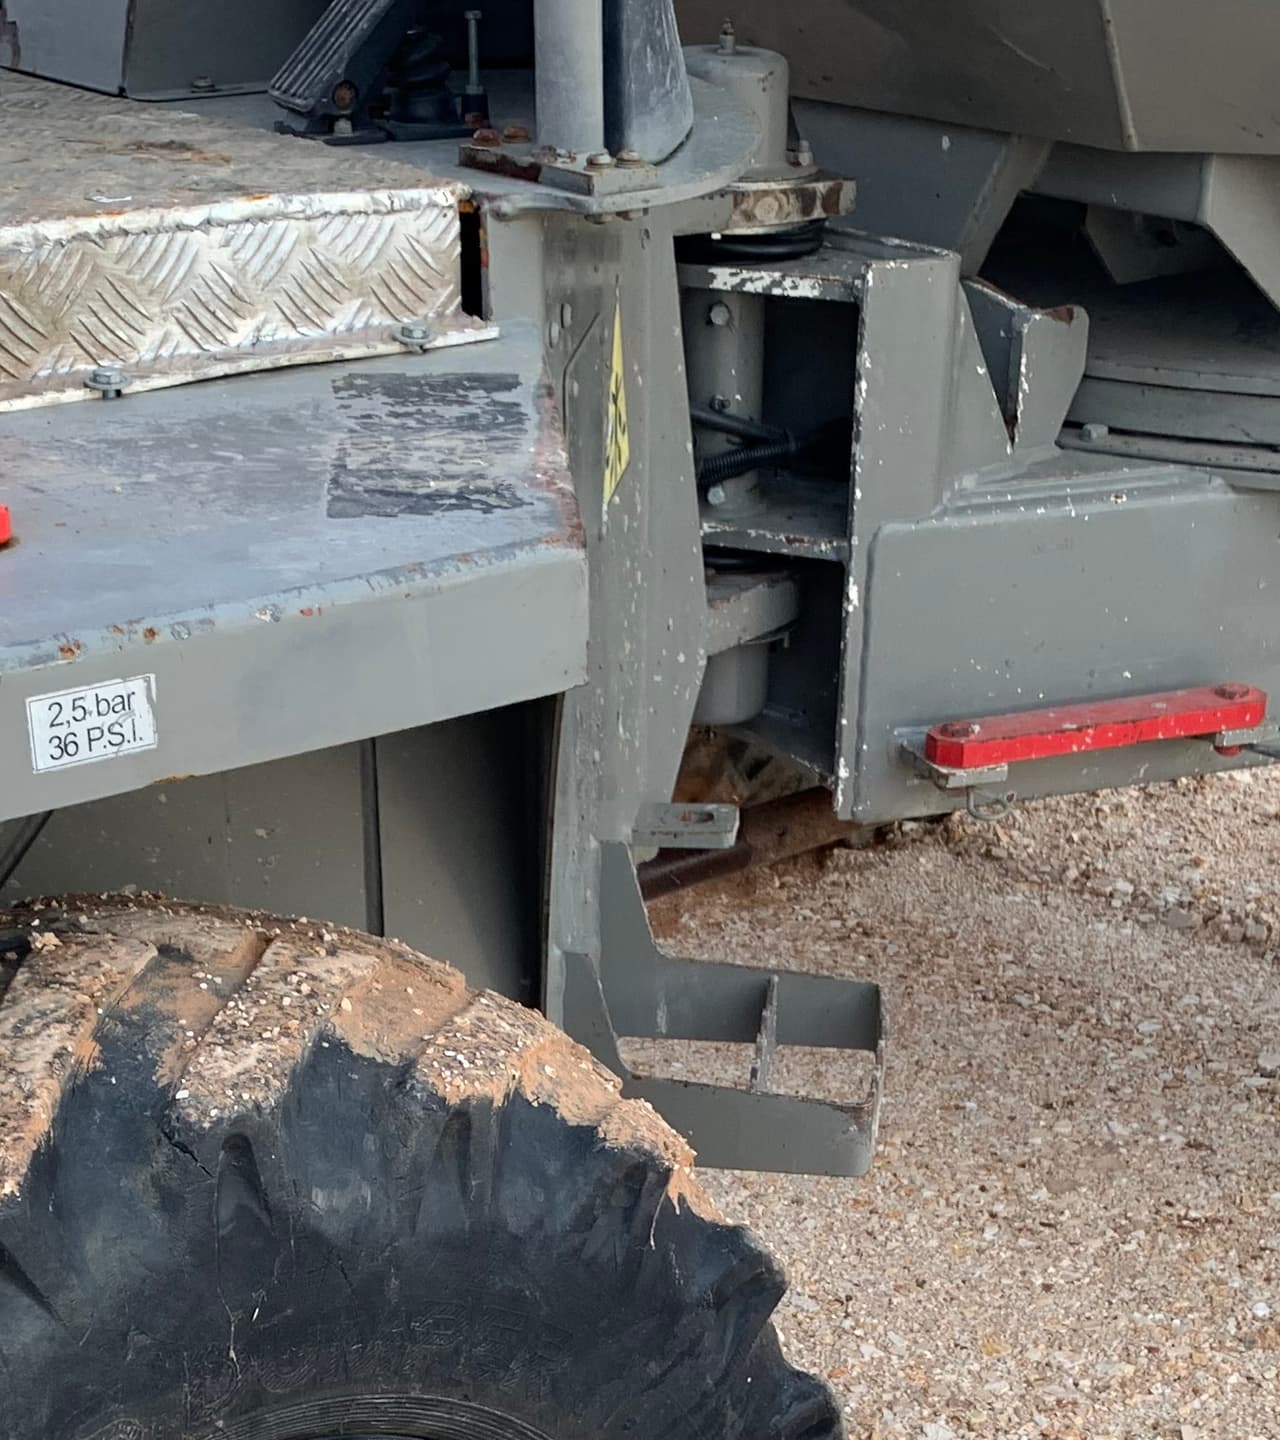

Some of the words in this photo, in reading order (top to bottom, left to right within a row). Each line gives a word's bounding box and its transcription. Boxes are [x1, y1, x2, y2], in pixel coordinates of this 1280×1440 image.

[47, 696, 87, 729] 2,5
[95, 692, 136, 717] bar
[48, 732, 80, 761] 36
[87, 718, 143, 752] P.S.I.
